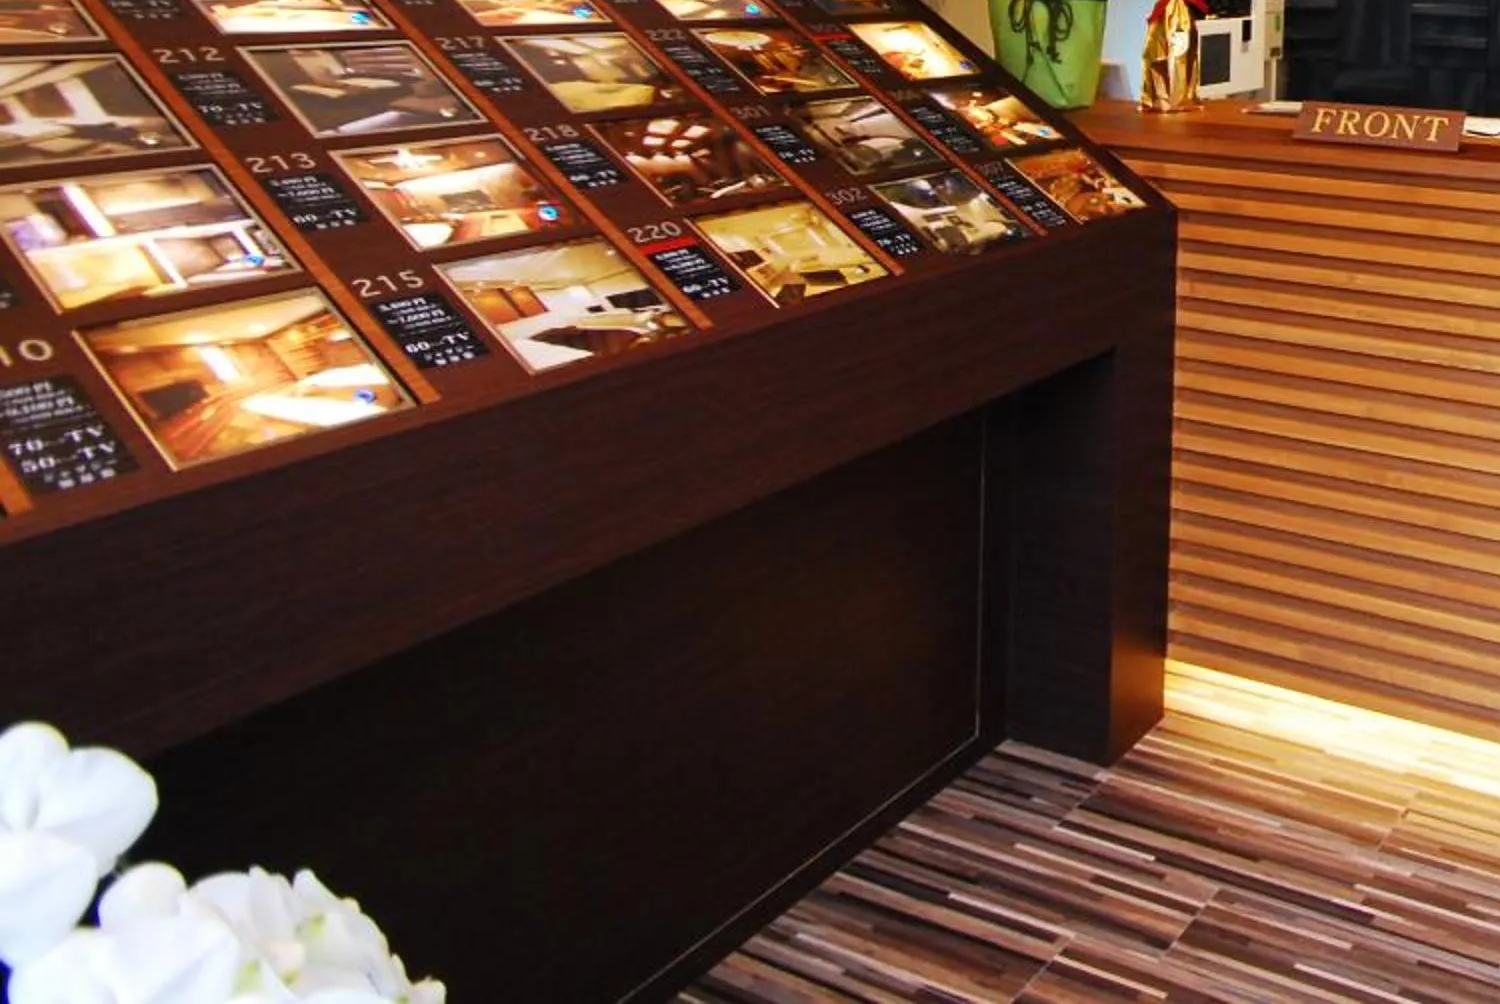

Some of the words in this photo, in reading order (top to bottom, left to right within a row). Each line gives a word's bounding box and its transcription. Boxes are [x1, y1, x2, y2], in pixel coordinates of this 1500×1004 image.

[152, 47, 225, 63] 212
[523, 124, 580, 141] 218
[1311, 108, 1449, 142] FRONT
[245, 153, 317, 173] 213
[627, 221, 683, 243] 220
[351, 270, 424, 297] 215
